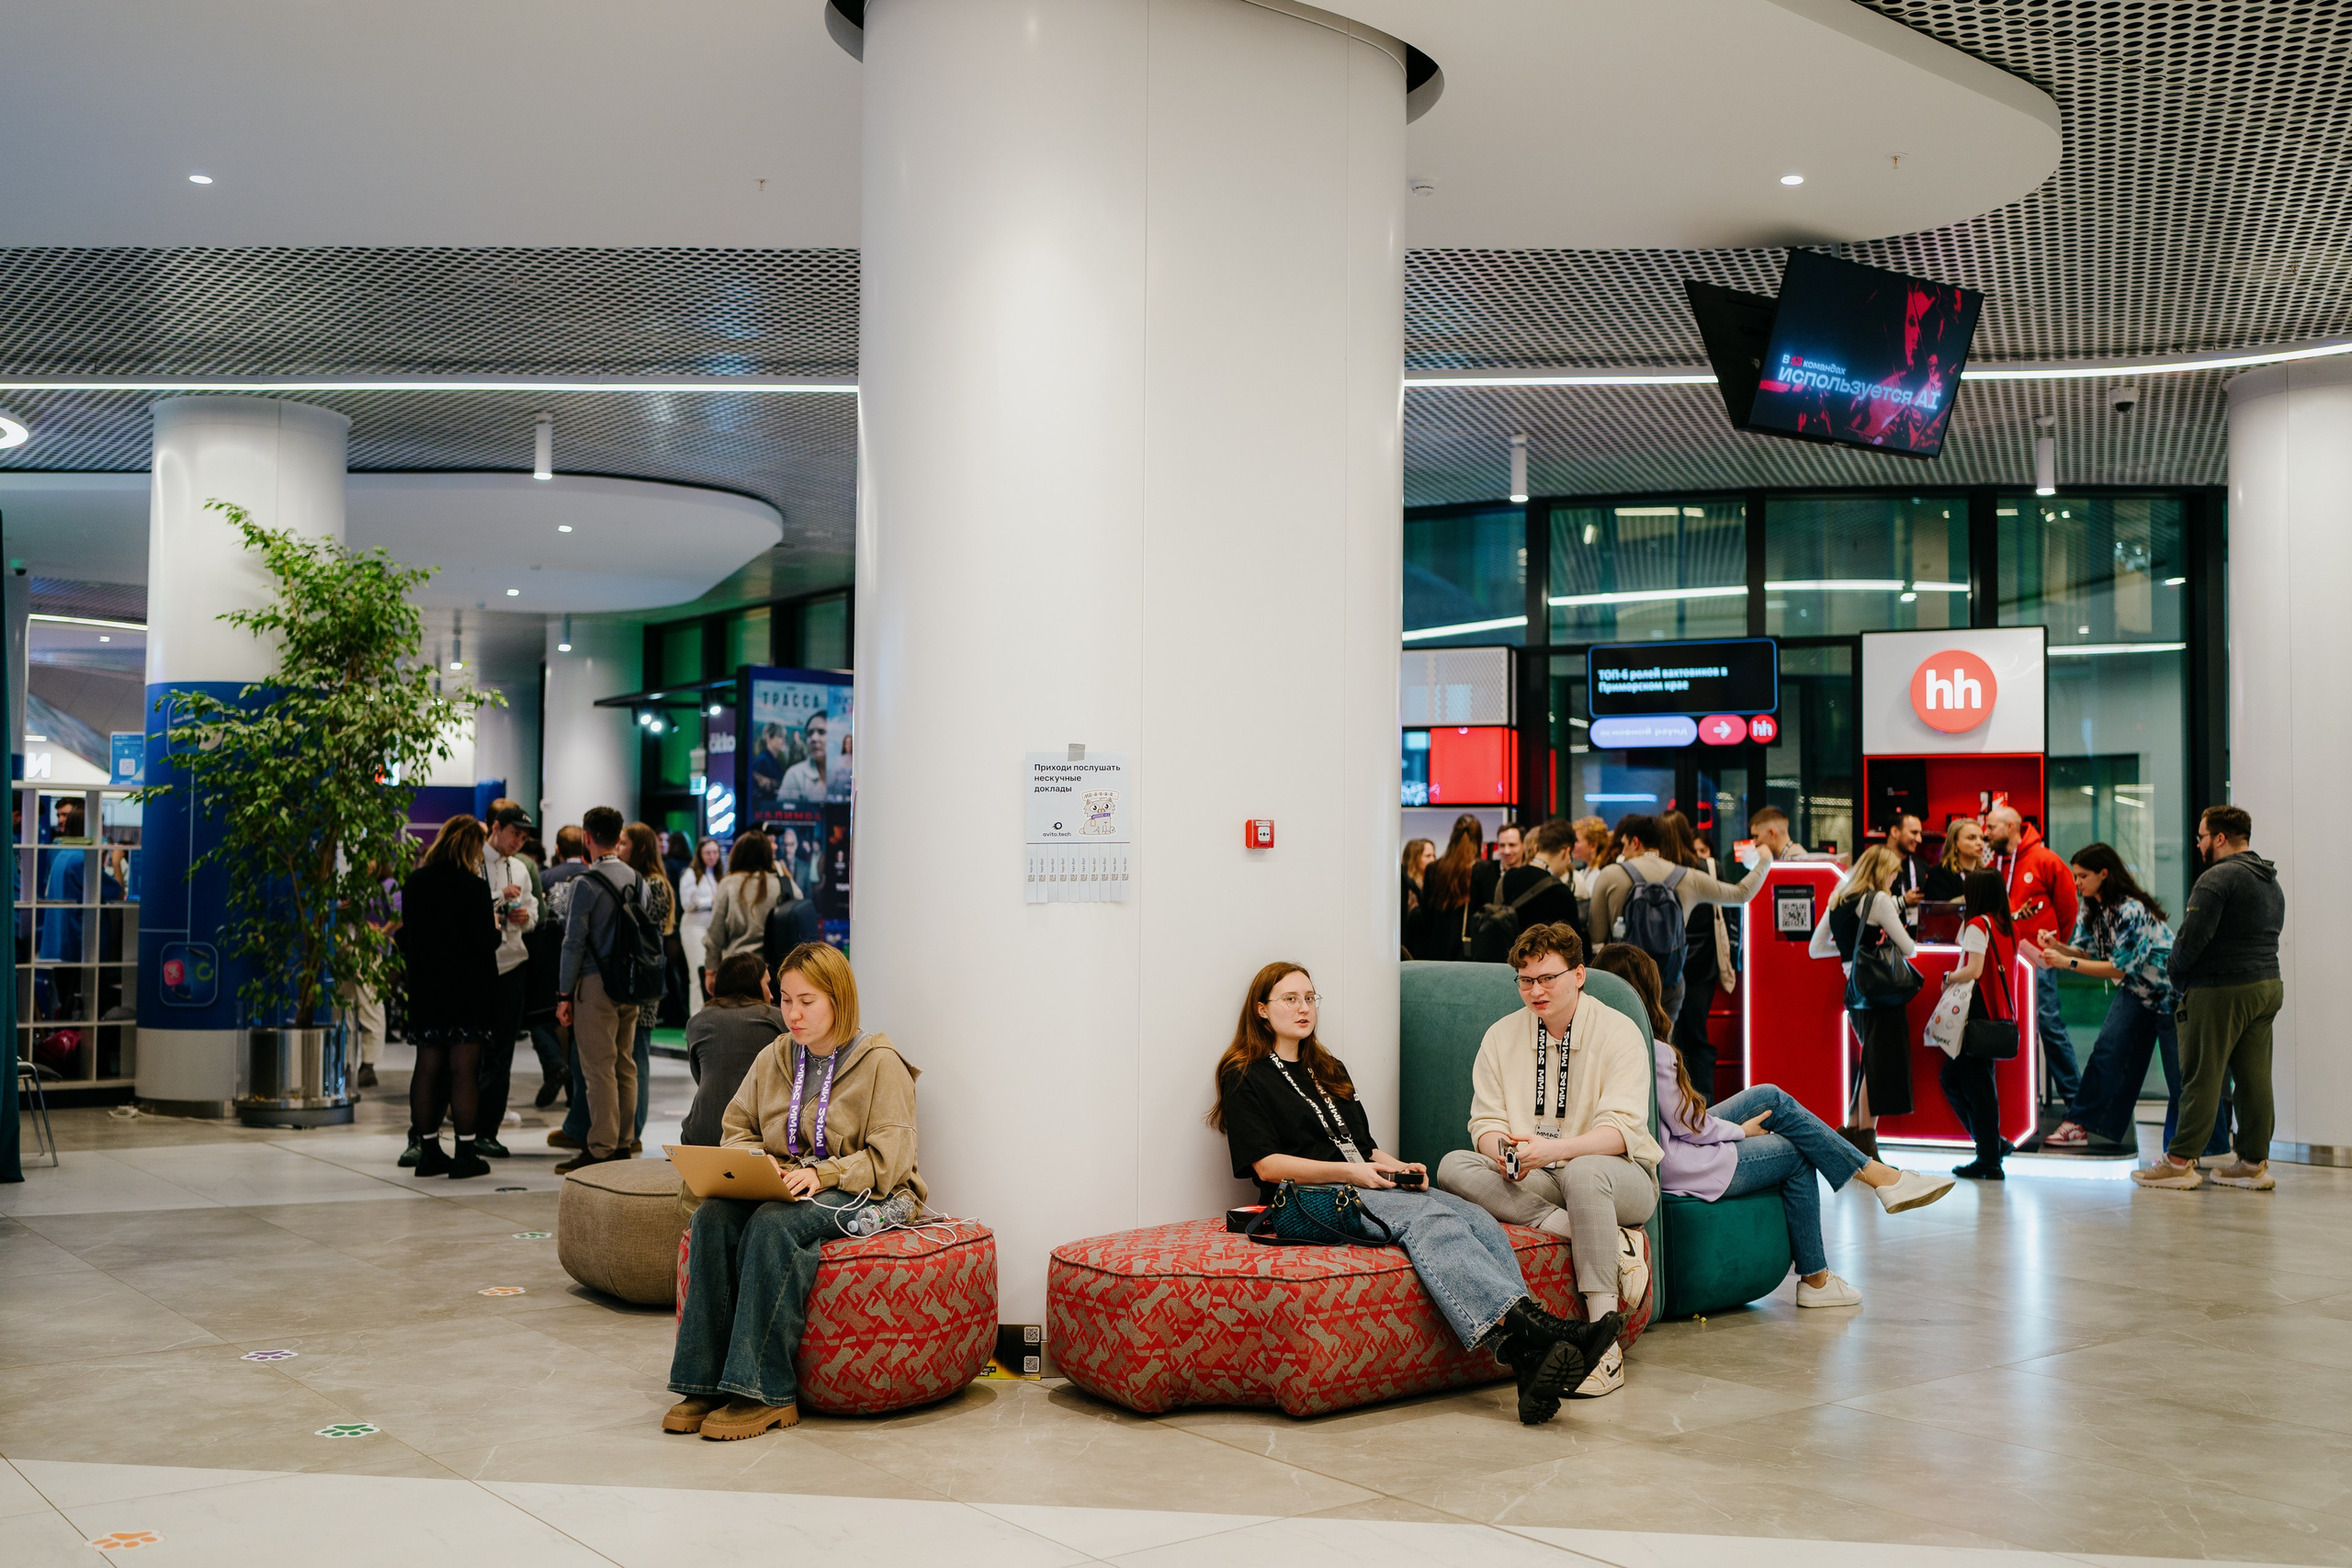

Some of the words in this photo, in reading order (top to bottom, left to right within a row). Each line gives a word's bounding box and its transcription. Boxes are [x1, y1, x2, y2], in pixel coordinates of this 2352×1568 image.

[1803, 359, 1847, 375] командах
[1916, 391, 1941, 410] AI
[1598, 669, 1628, 681] ТОП-6
[1630, 667, 1661, 682] ролей
[1662, 667, 1720, 679] вахтовиков
[1720, 667, 1728, 677] в
[1598, 681, 1663, 694] Приморском
[1664, 680, 1690, 693] крае
[1926, 669, 1982, 710] hh
[763, 691, 820, 708] ТРАССА
[1752, 720, 1773, 737] hh
[1034, 763, 1071, 773] Приходи
[1073, 764, 1121, 773] послушать
